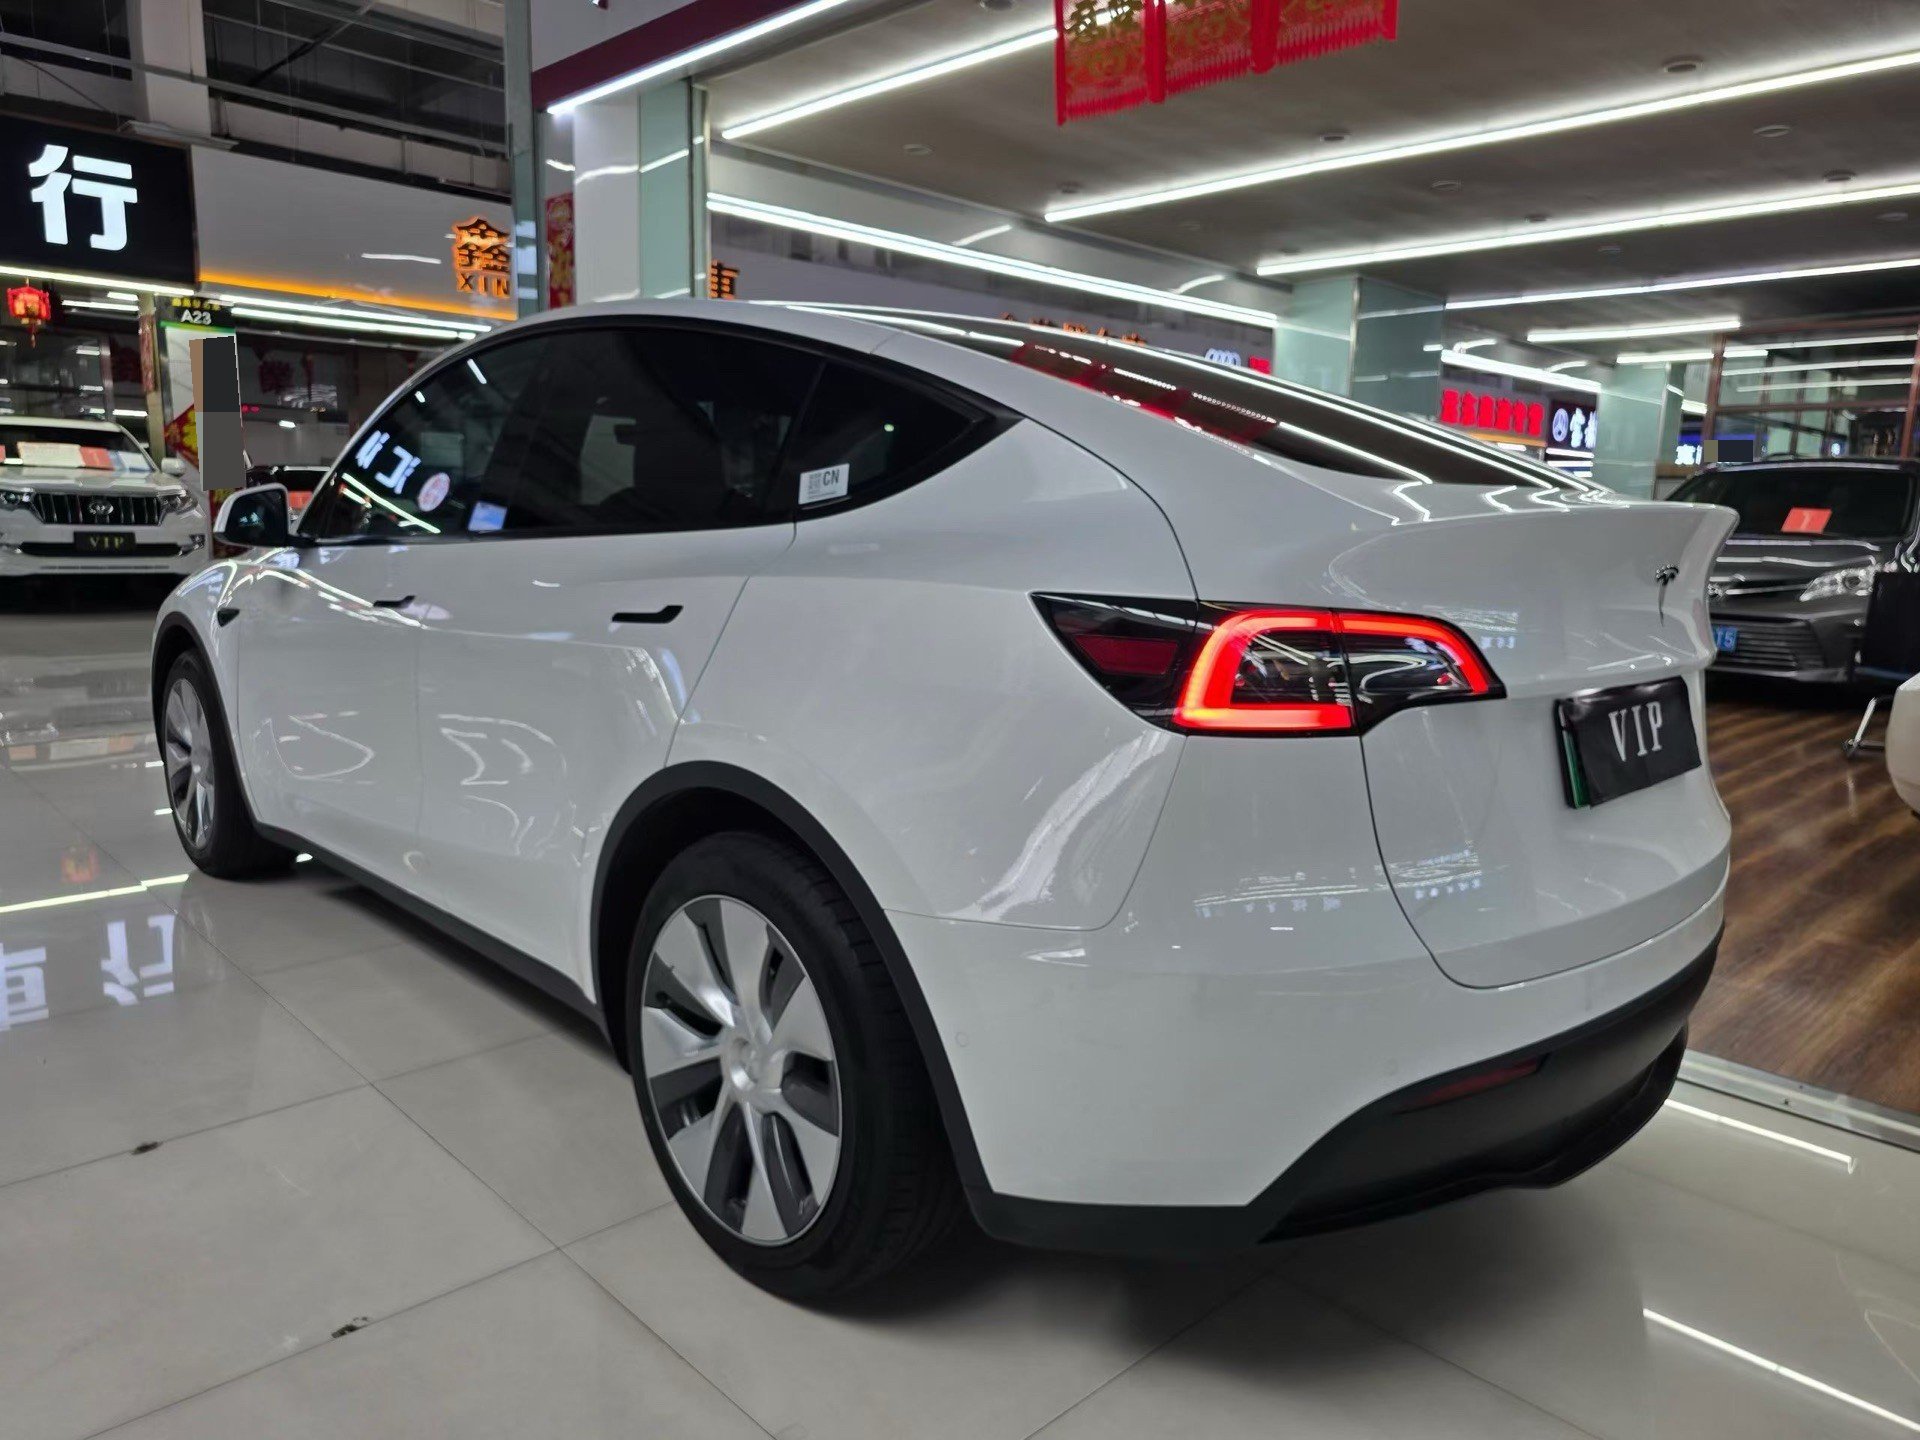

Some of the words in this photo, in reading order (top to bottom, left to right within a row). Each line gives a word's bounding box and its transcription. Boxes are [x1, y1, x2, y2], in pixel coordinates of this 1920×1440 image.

[29, 144, 138, 250] 行
[455, 217, 511, 275] 鑫
[180, 308, 212, 326] A23
[822, 468, 841, 487] CN
[89, 536, 125, 550] VIP
[1607, 701, 1663, 763] VIP
